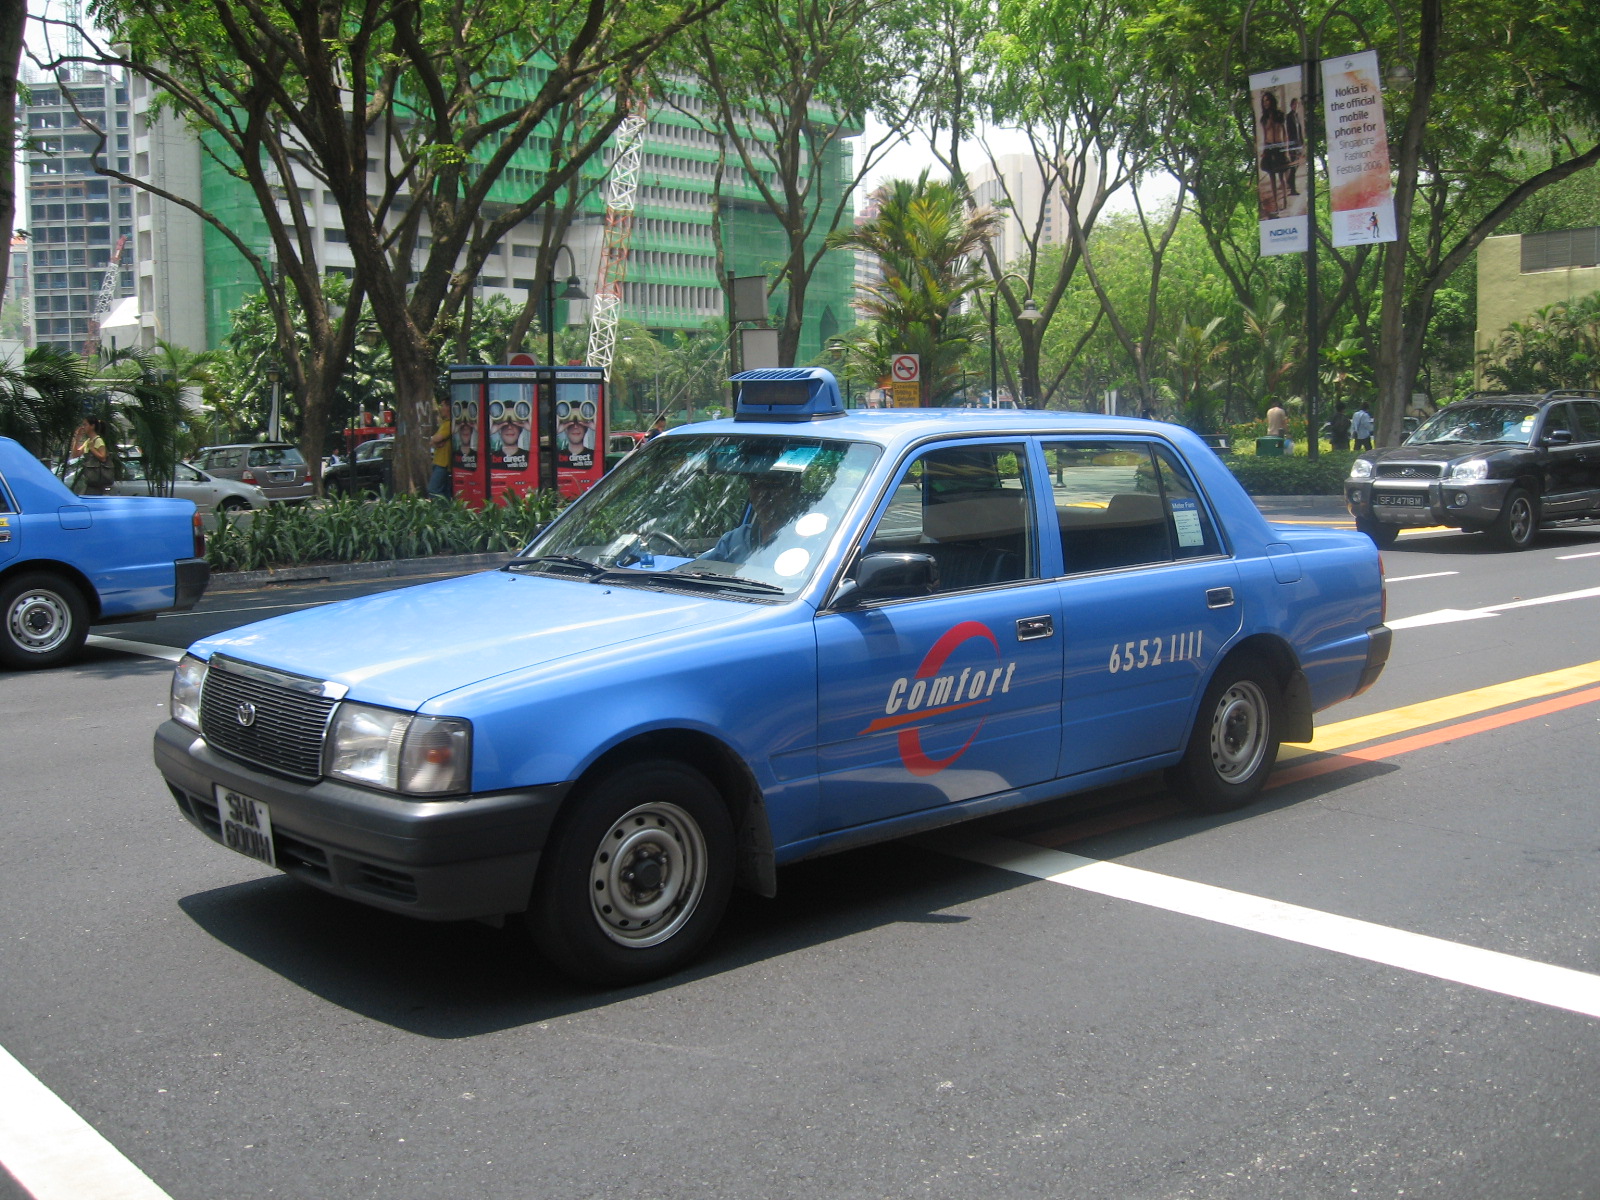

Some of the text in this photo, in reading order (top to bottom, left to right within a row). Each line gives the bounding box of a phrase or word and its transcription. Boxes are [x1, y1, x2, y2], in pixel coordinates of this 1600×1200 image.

[1335, 83, 1368, 98] Nokia is
[1331, 96, 1376, 112] the official
[1339, 112, 1369, 124] mobile
[1334, 122, 1376, 139] phone for
[1339, 137, 1375, 150] Singapore
[1344, 150, 1371, 161] Fashion
[1336, 160, 1382, 175] Festival 2006
[1269, 227, 1298, 237] NOKIA
[503, 453, 526, 463] direct
[568, 453, 591, 462] direct
[1109, 629, 1203, 674] 6552 1111
[885, 661, 1017, 716] Comfort
[225, 792, 260, 830] SHA
